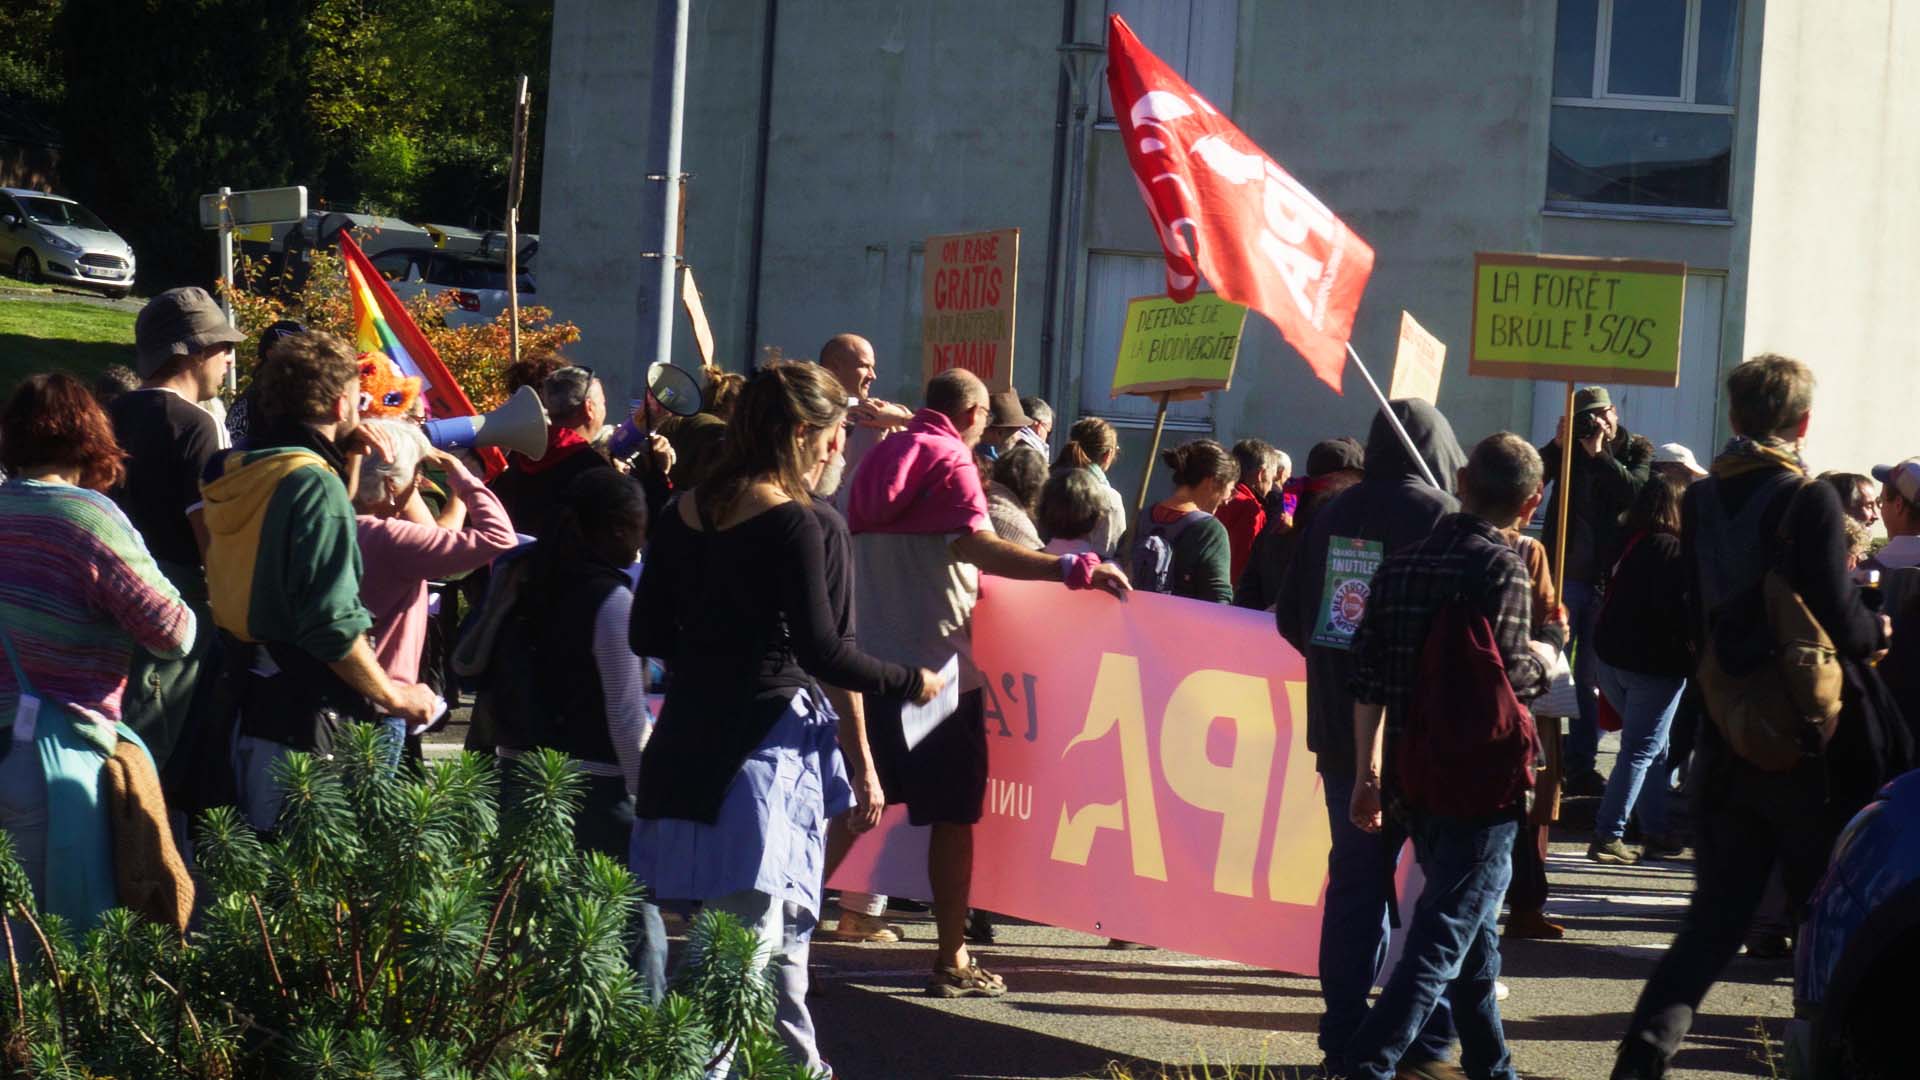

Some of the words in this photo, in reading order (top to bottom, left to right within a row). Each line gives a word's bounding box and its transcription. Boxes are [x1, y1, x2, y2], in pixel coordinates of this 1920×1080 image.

[943, 240, 960, 263] ON
[962, 236, 1000, 264] RASE
[934, 264, 1003, 311] GRATIS
[1491, 271, 1520, 304] LA
[1533, 272, 1621, 311] FORÊT
[1200, 303, 1225, 325] DE
[1590, 313, 1658, 360] SOS
[932, 339, 998, 380] DEMAIN
